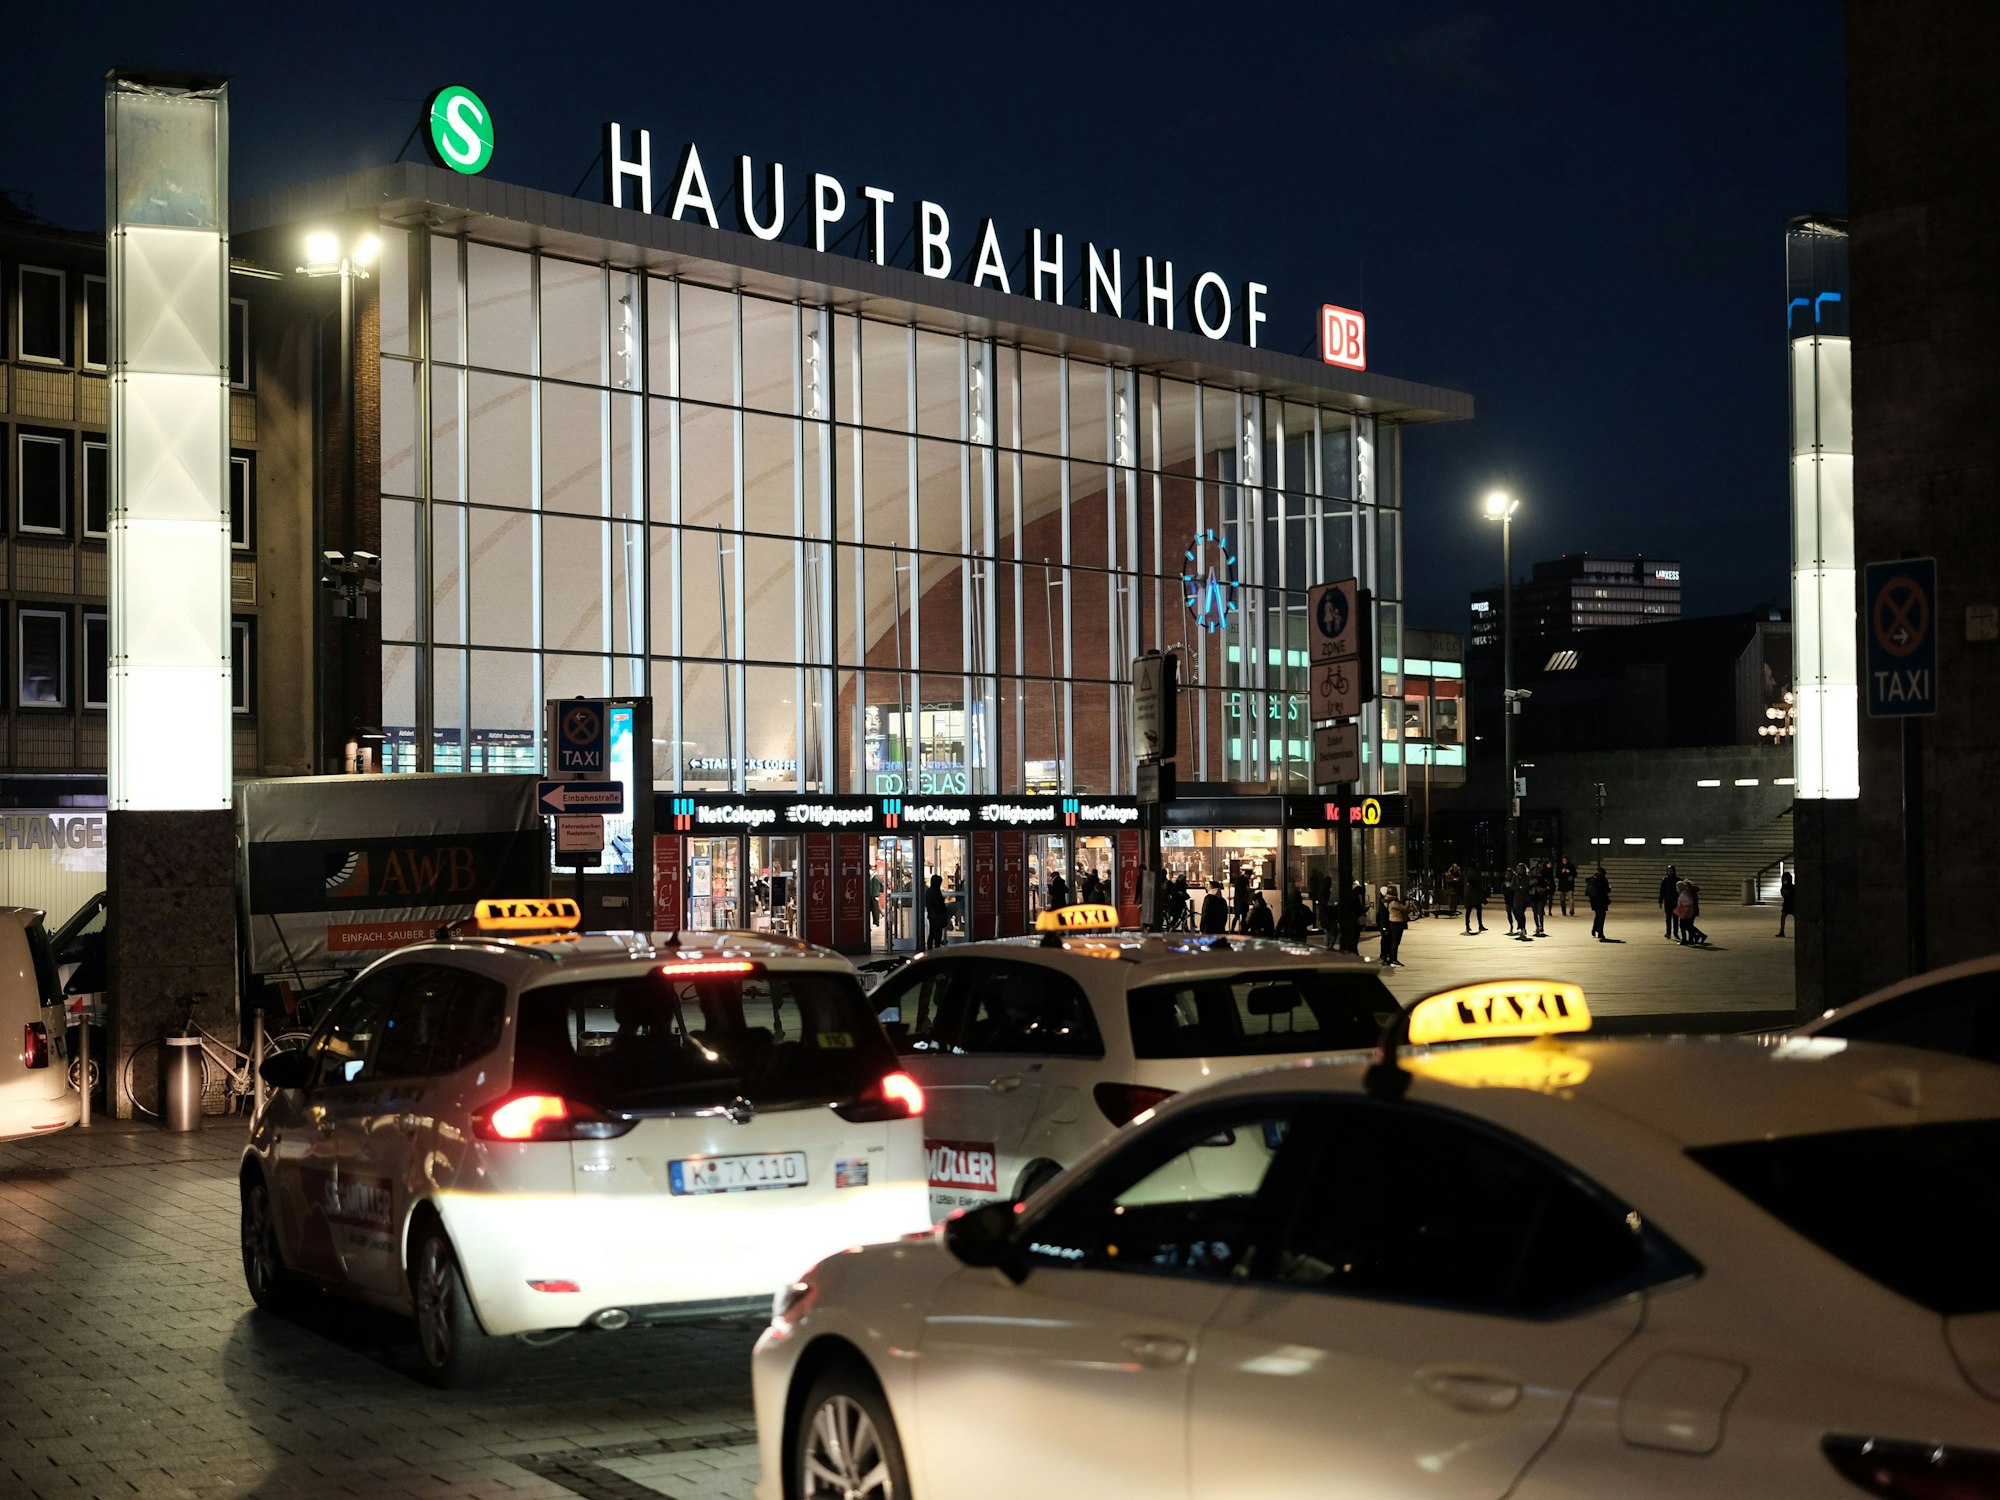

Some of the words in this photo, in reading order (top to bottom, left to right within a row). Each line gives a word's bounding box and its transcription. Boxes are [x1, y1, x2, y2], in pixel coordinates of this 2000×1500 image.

[442, 95, 483, 166] S
[610, 121, 1268, 349] HAUPTBAHNHOF
[1328, 314, 1362, 361] DB
[1321, 639, 1346, 657] ZONE
[1874, 669, 1929, 702] TAXI
[562, 751, 599, 766] TAXI
[700, 757, 763, 770] STARBKS
[875, 772, 967, 795] DOGLAS
[562, 793, 620, 803] Einbahnstraße
[697, 804, 776, 827] NetCologne
[809, 804, 873, 826] Highspeed
[904, 804, 971, 826] NetCologne
[999, 804, 1055, 825] Highspeed
[1080, 804, 1139, 823] NetCologne
[1324, 802, 1362, 824] Kaps
[0, 817, 103, 850] HANGE
[561, 822, 602, 831] Fahrradparken
[377, 847, 478, 896] AWB
[495, 903, 569, 918] TAXI
[1060, 910, 1112, 926] TAXI
[341, 931, 386, 943] EINFACH.
[387, 929, 427, 941] SAUBER.
[1461, 993, 1557, 1024] TAXI
[692, 1165, 706, 1186] K
[758, 1157, 797, 1180] 110
